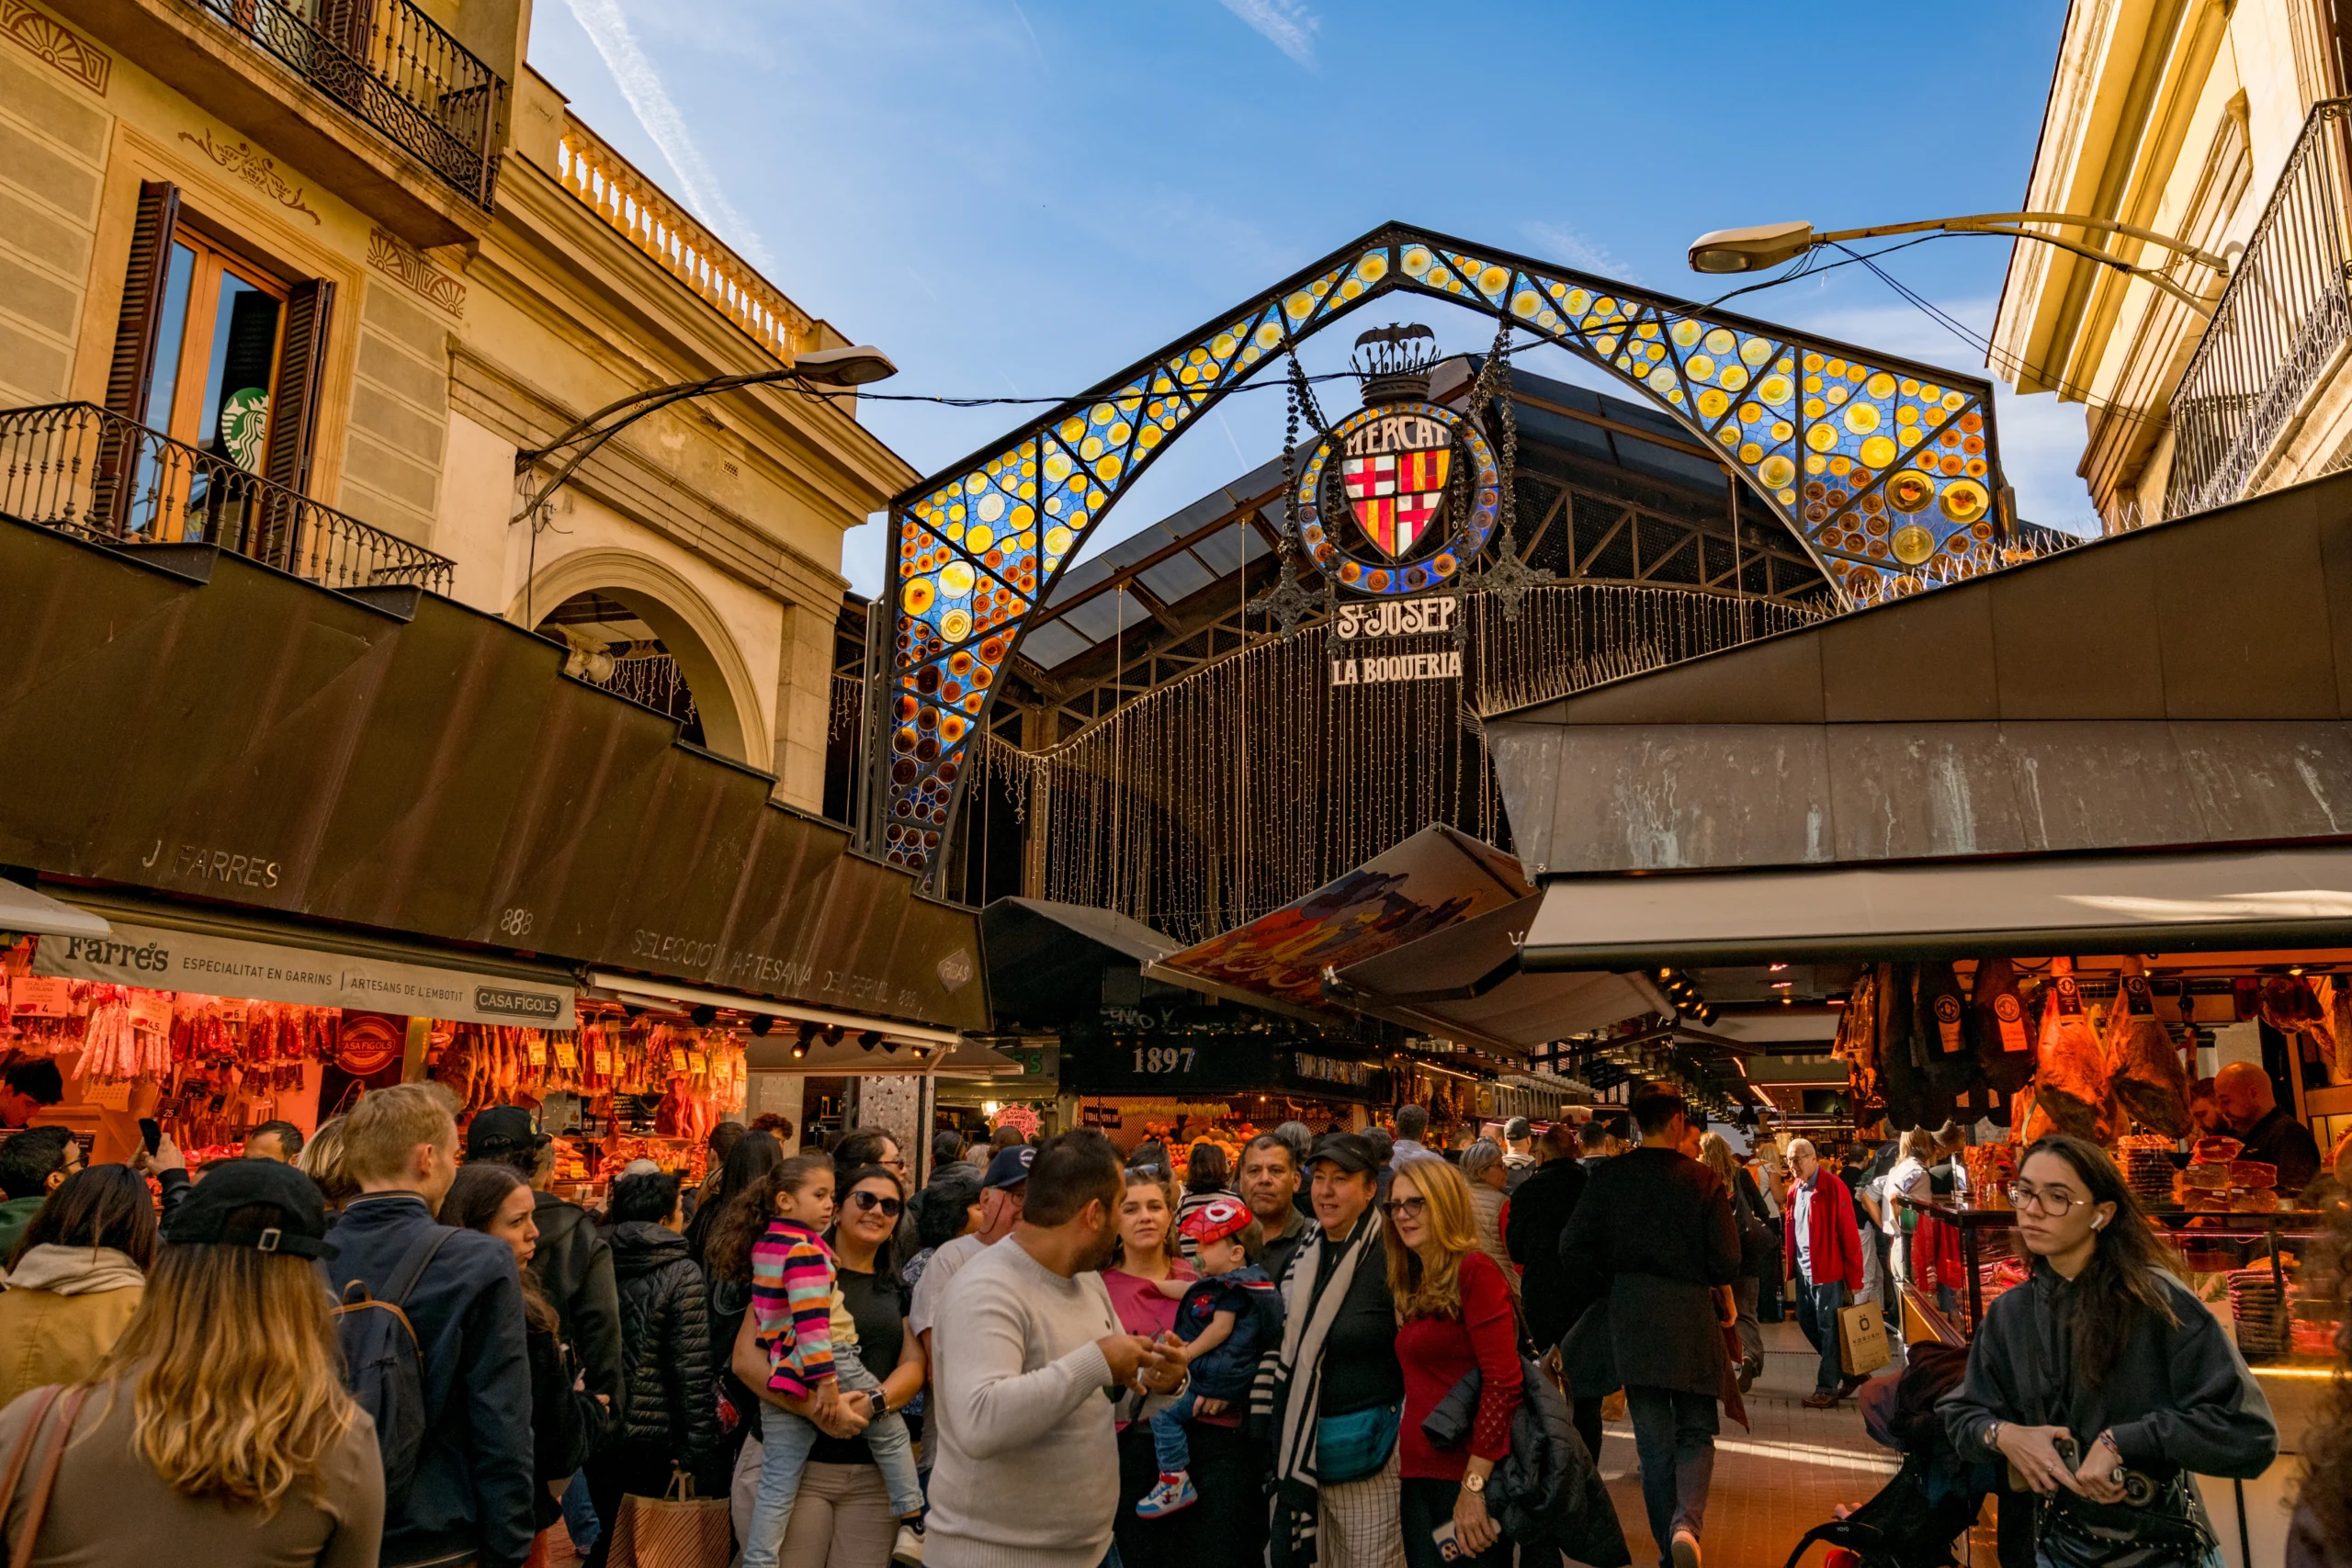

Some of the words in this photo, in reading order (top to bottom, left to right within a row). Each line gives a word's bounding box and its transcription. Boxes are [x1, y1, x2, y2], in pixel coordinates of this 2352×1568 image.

[1346, 416, 1448, 457] MERCAT
[1364, 597, 1456, 637] JOSEP
[1332, 659, 1359, 685] LA
[1363, 651, 1463, 683] BOQUERIA
[141, 840, 162, 868] J
[172, 844, 281, 889] FARRES
[501, 908, 533, 936] 888
[183, 957, 265, 978] ESPECIALITAT
[266, 967, 282, 980] EN
[285, 970, 333, 986] GARRINS
[351, 977, 401, 995] ARTESANS
[404, 985, 415, 996] DE
[418, 986, 463, 1002] L'EMBOTIT
[479, 992, 513, 1010] CASA
[41, 1003, 49, 1013] 4
[234, 1009, 240, 1020] 6
[148, 1021, 160, 1032] 4,5
[1132, 1047, 1195, 1073] 1897
[163, 1109, 175, 1118] 25
[1102, 1113, 1112, 1122] ONS
[1859, 1314, 1871, 1331] Ö
